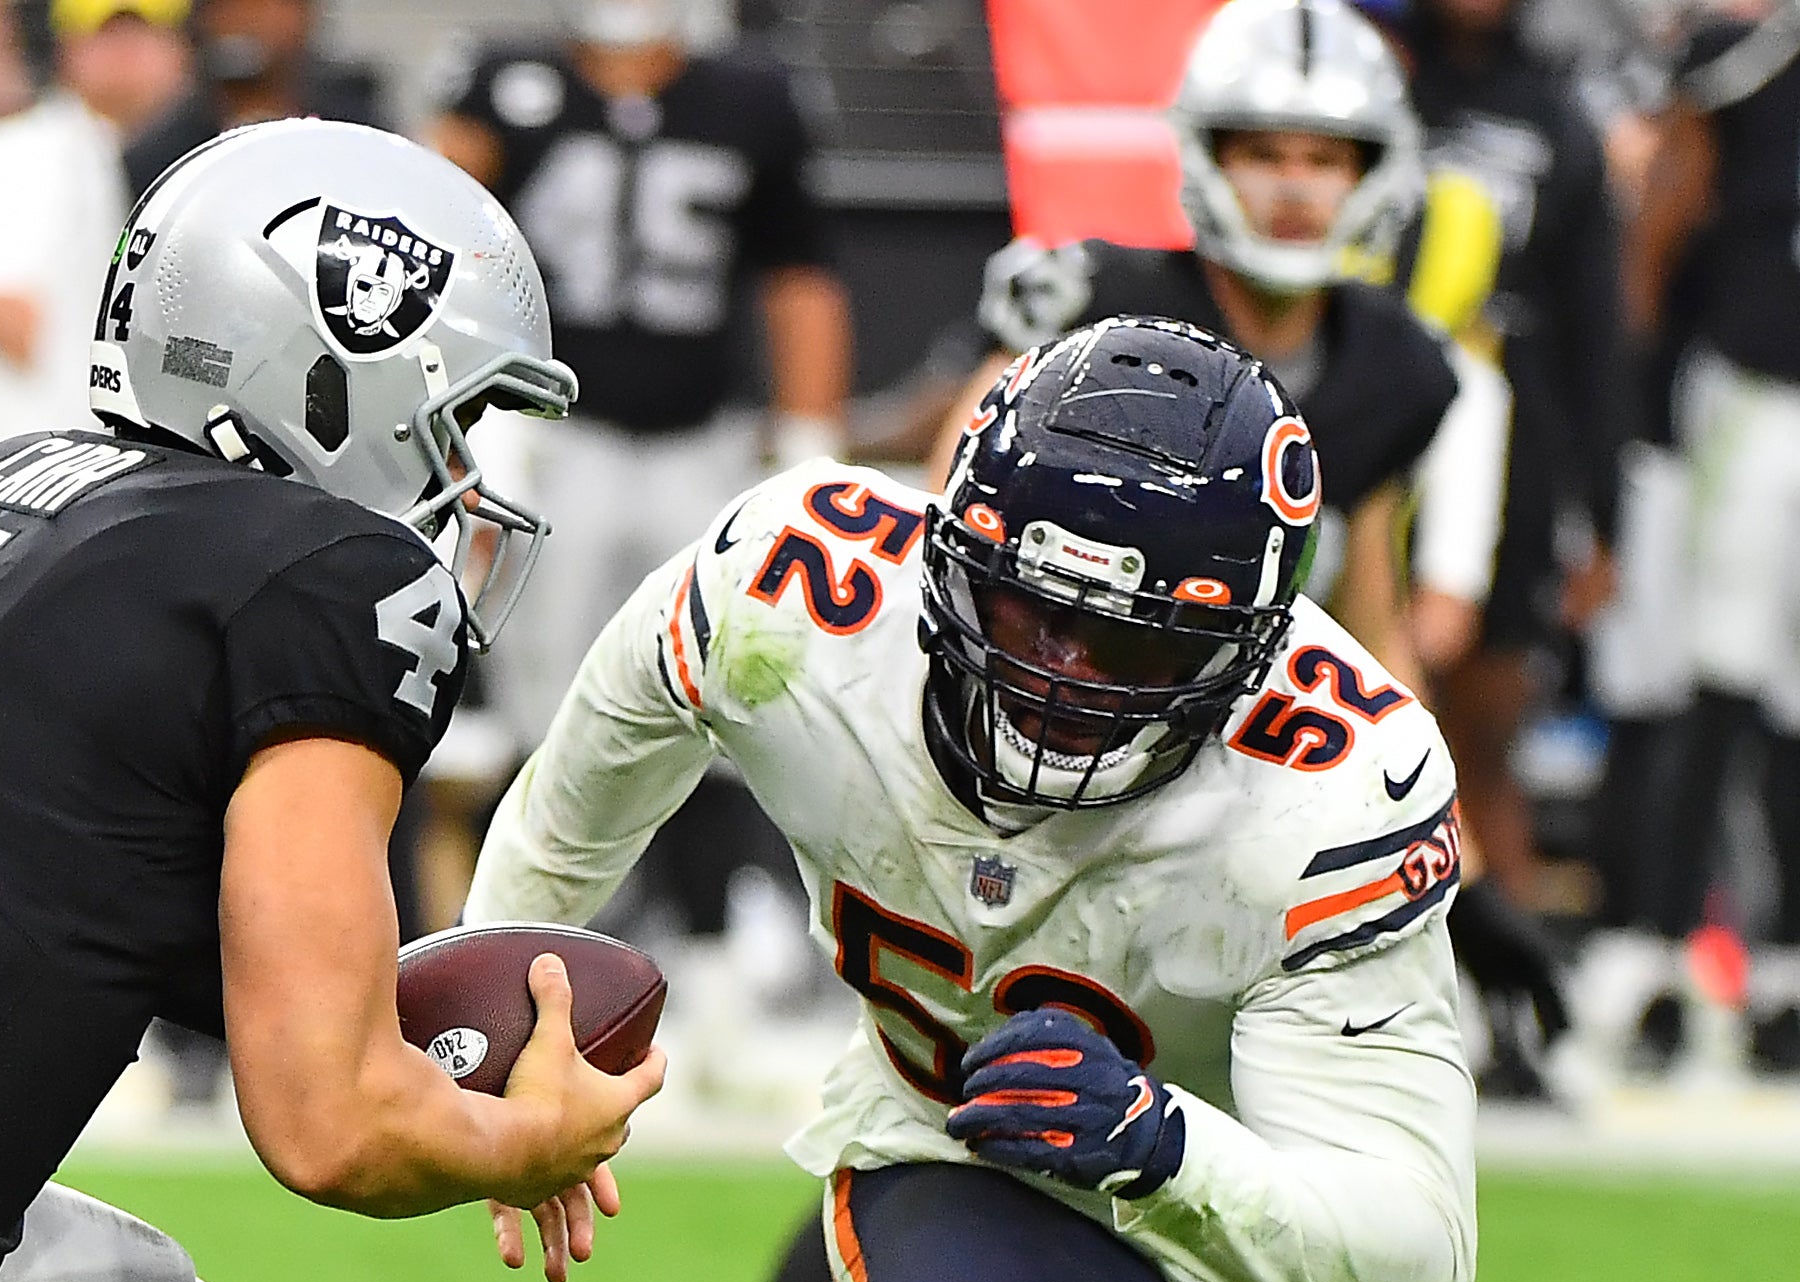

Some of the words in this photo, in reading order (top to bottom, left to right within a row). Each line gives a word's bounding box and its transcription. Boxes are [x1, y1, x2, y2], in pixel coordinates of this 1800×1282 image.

[130, 233, 151, 256] AL
[335, 211, 443, 266] RAIDERS
[515, 132, 753, 336] 45
[109, 282, 136, 342] 4
[745, 481, 926, 637] 52
[374, 562, 462, 719] 4
[1227, 645, 1415, 773] 52
[976, 874, 1008, 900] NFL
[433, 1030, 468, 1060] 240
